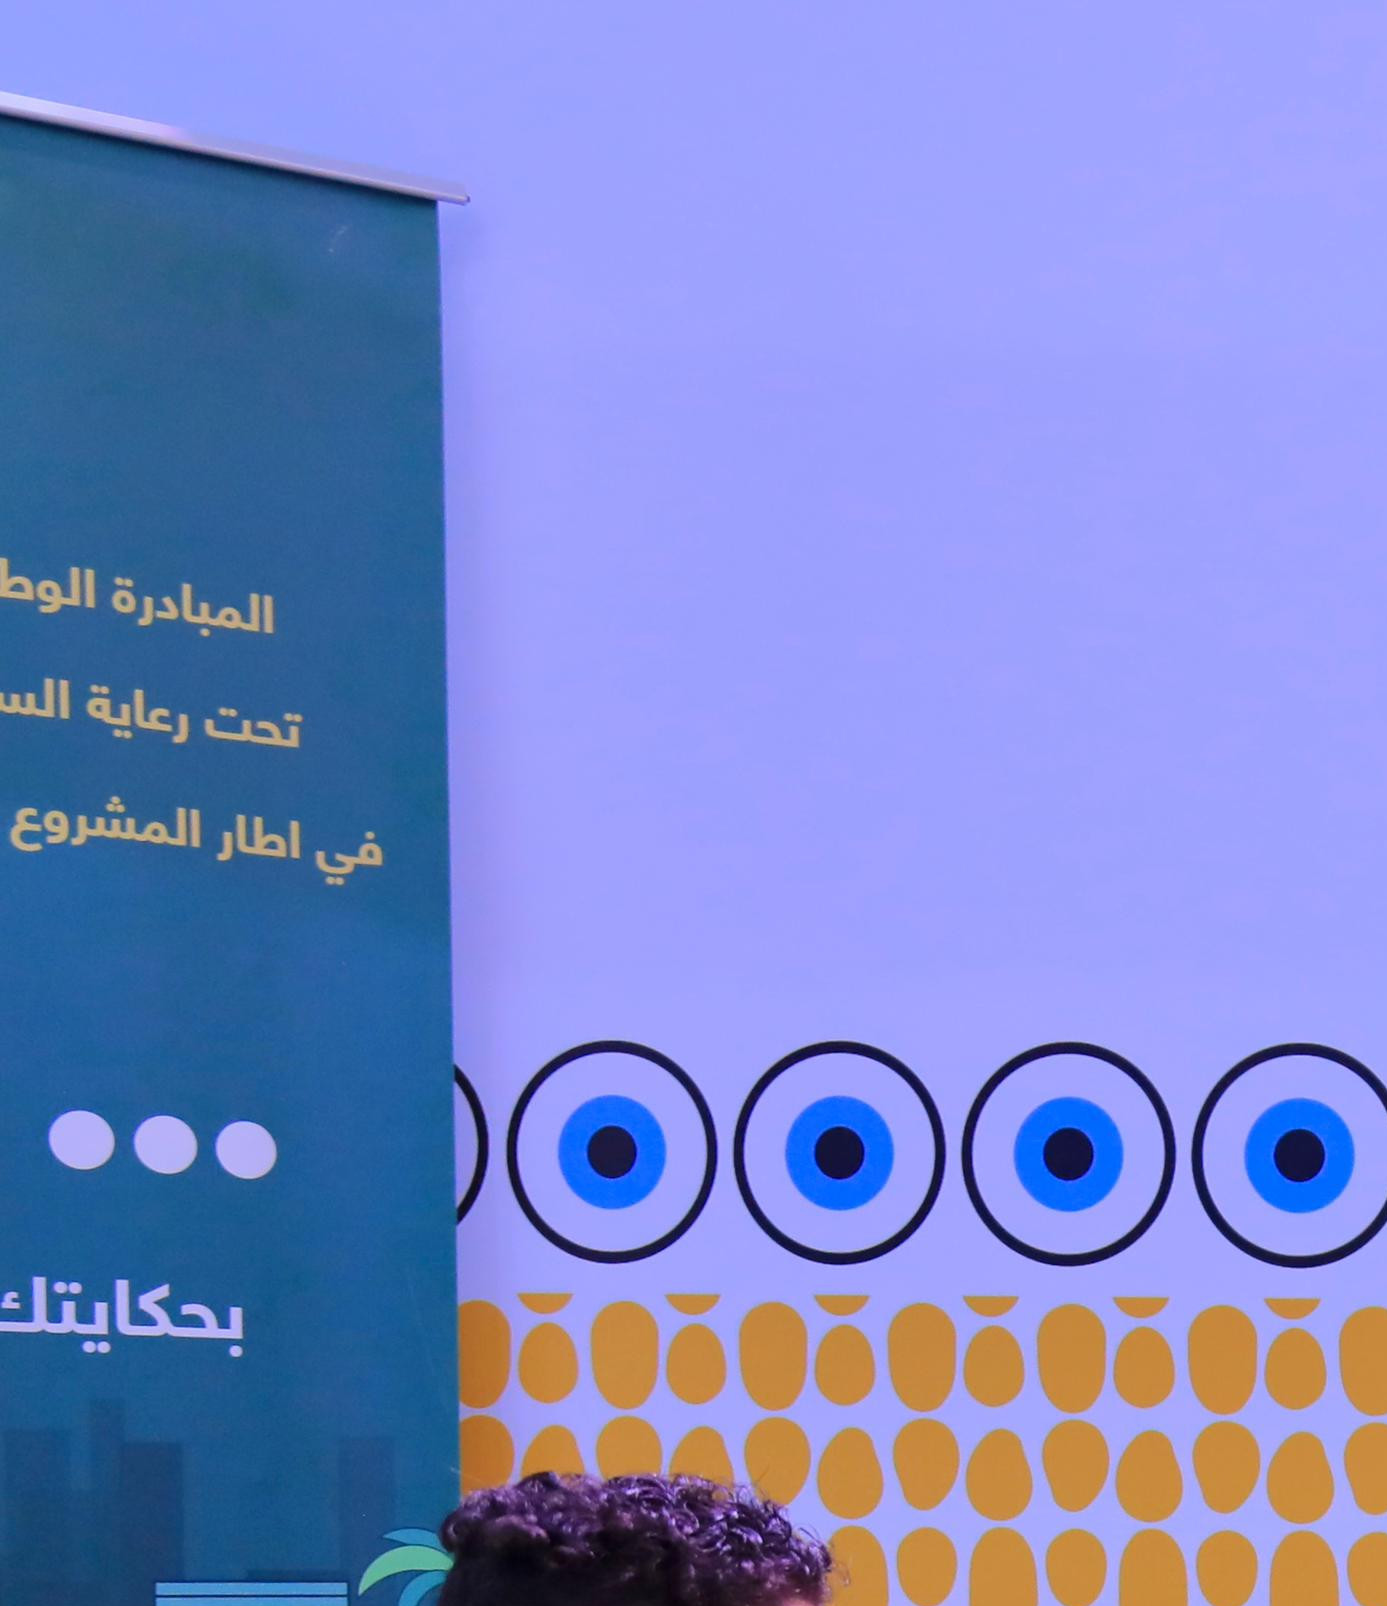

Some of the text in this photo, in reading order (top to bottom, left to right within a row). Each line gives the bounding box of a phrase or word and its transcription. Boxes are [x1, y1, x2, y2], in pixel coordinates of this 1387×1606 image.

[111, 576, 275, 637] المبادرة
[86, 683, 190, 744] رعاية
[204, 706, 303, 748] تحت
[9, 795, 384, 886] في اطار المشروع
